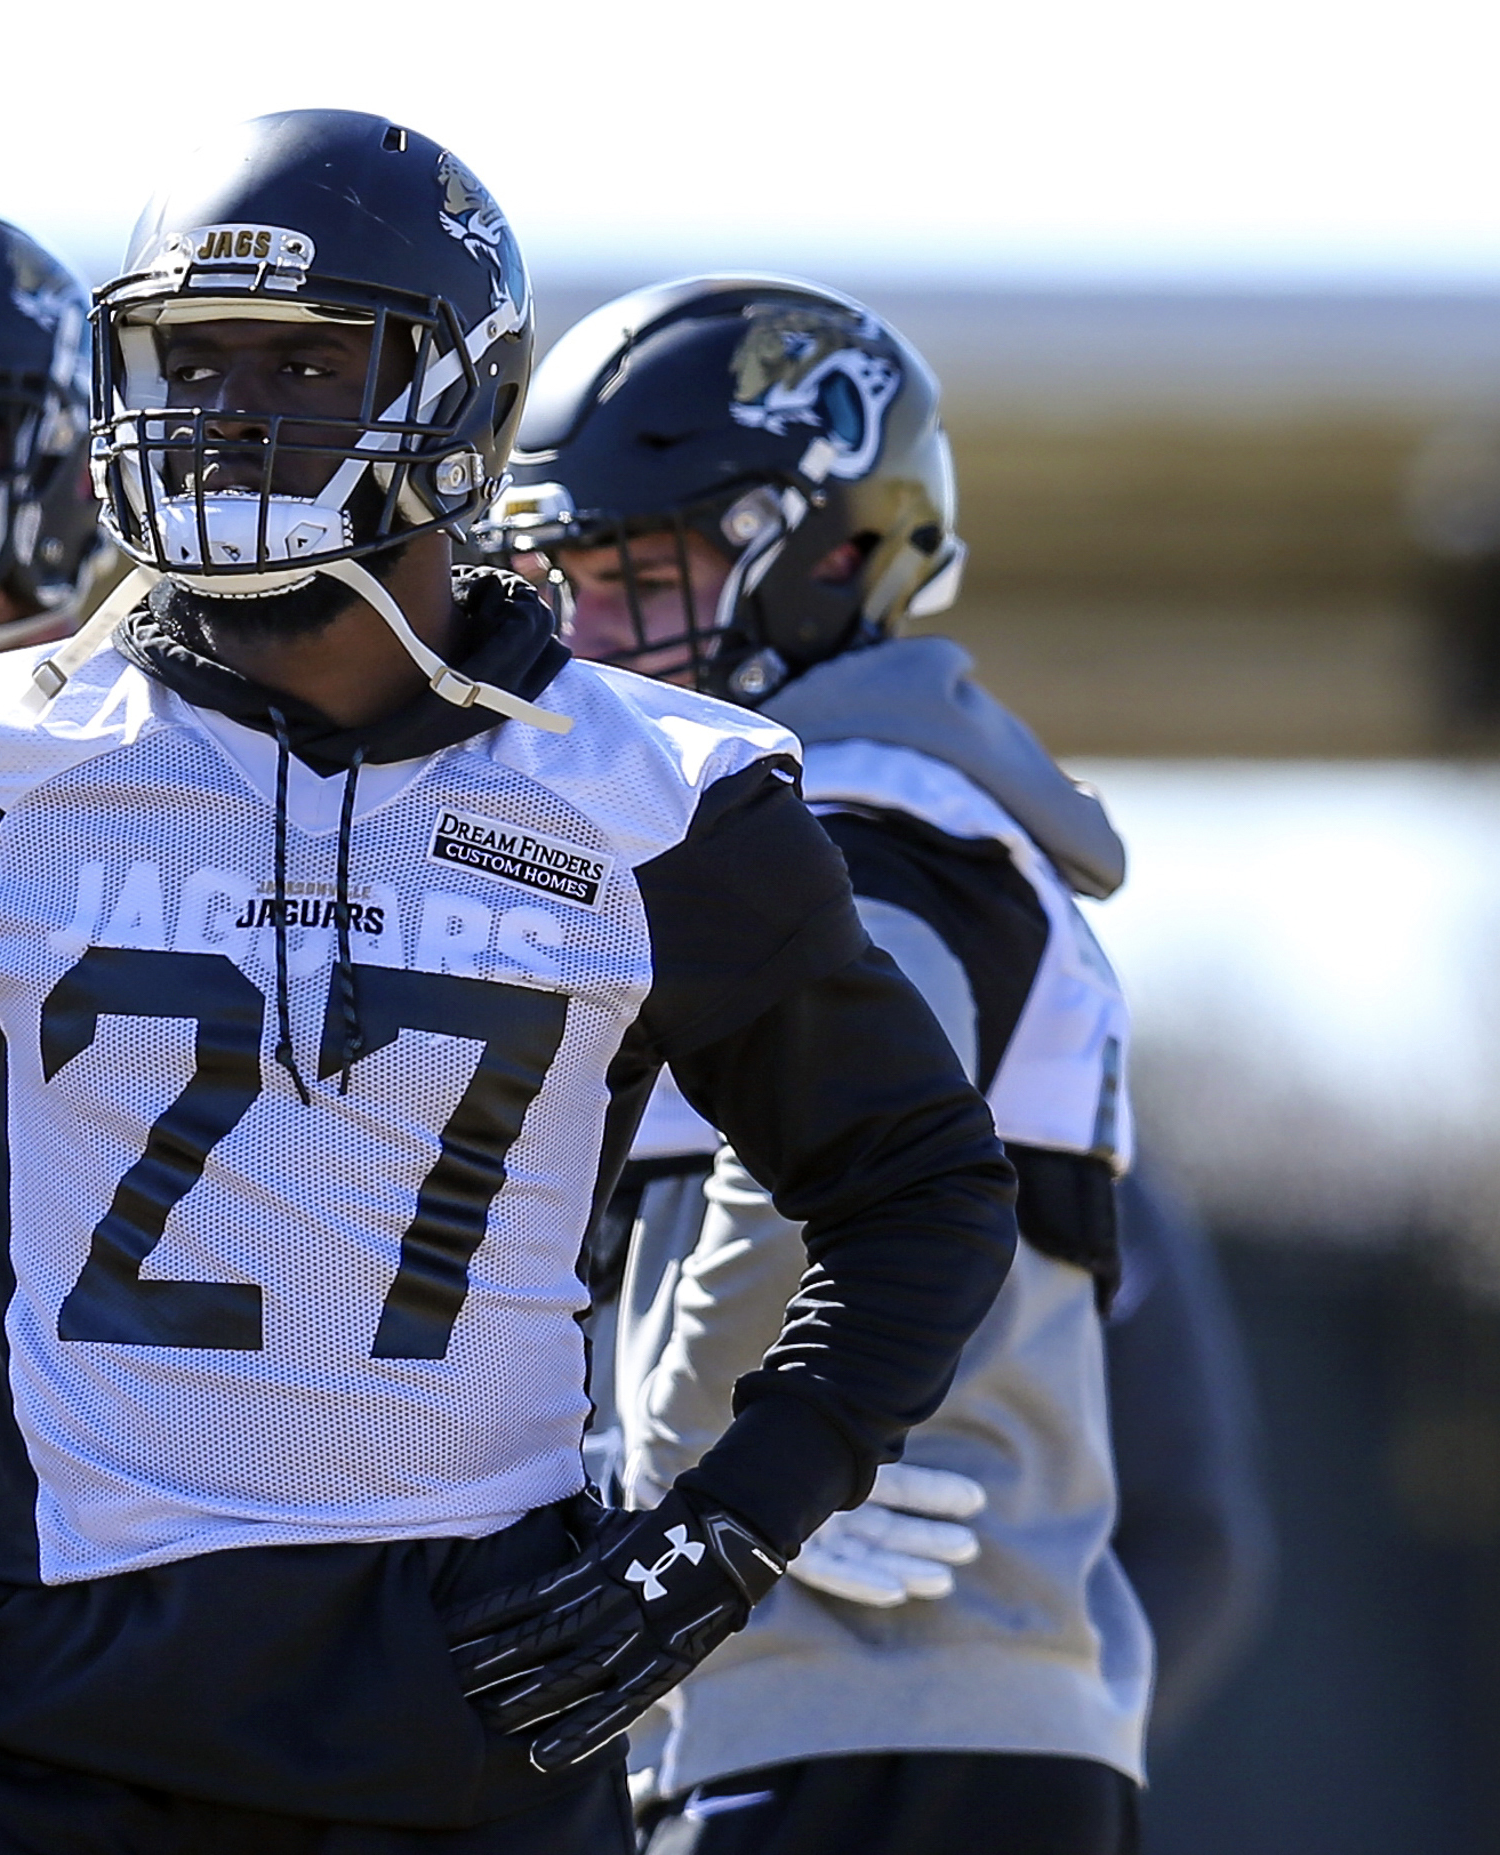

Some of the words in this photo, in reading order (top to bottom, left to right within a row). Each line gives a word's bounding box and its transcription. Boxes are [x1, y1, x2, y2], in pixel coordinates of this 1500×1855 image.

[197, 230, 272, 260] JAGS
[436, 812, 518, 853] DREAM
[518, 834, 605, 881] FINDERS
[256, 880, 372, 899] JAKSONVLE
[445, 842, 520, 878] CUSTOM
[523, 865, 588, 899] HOMES
[235, 899, 385, 935] JAGUARS
[40, 945, 571, 1360] 27
